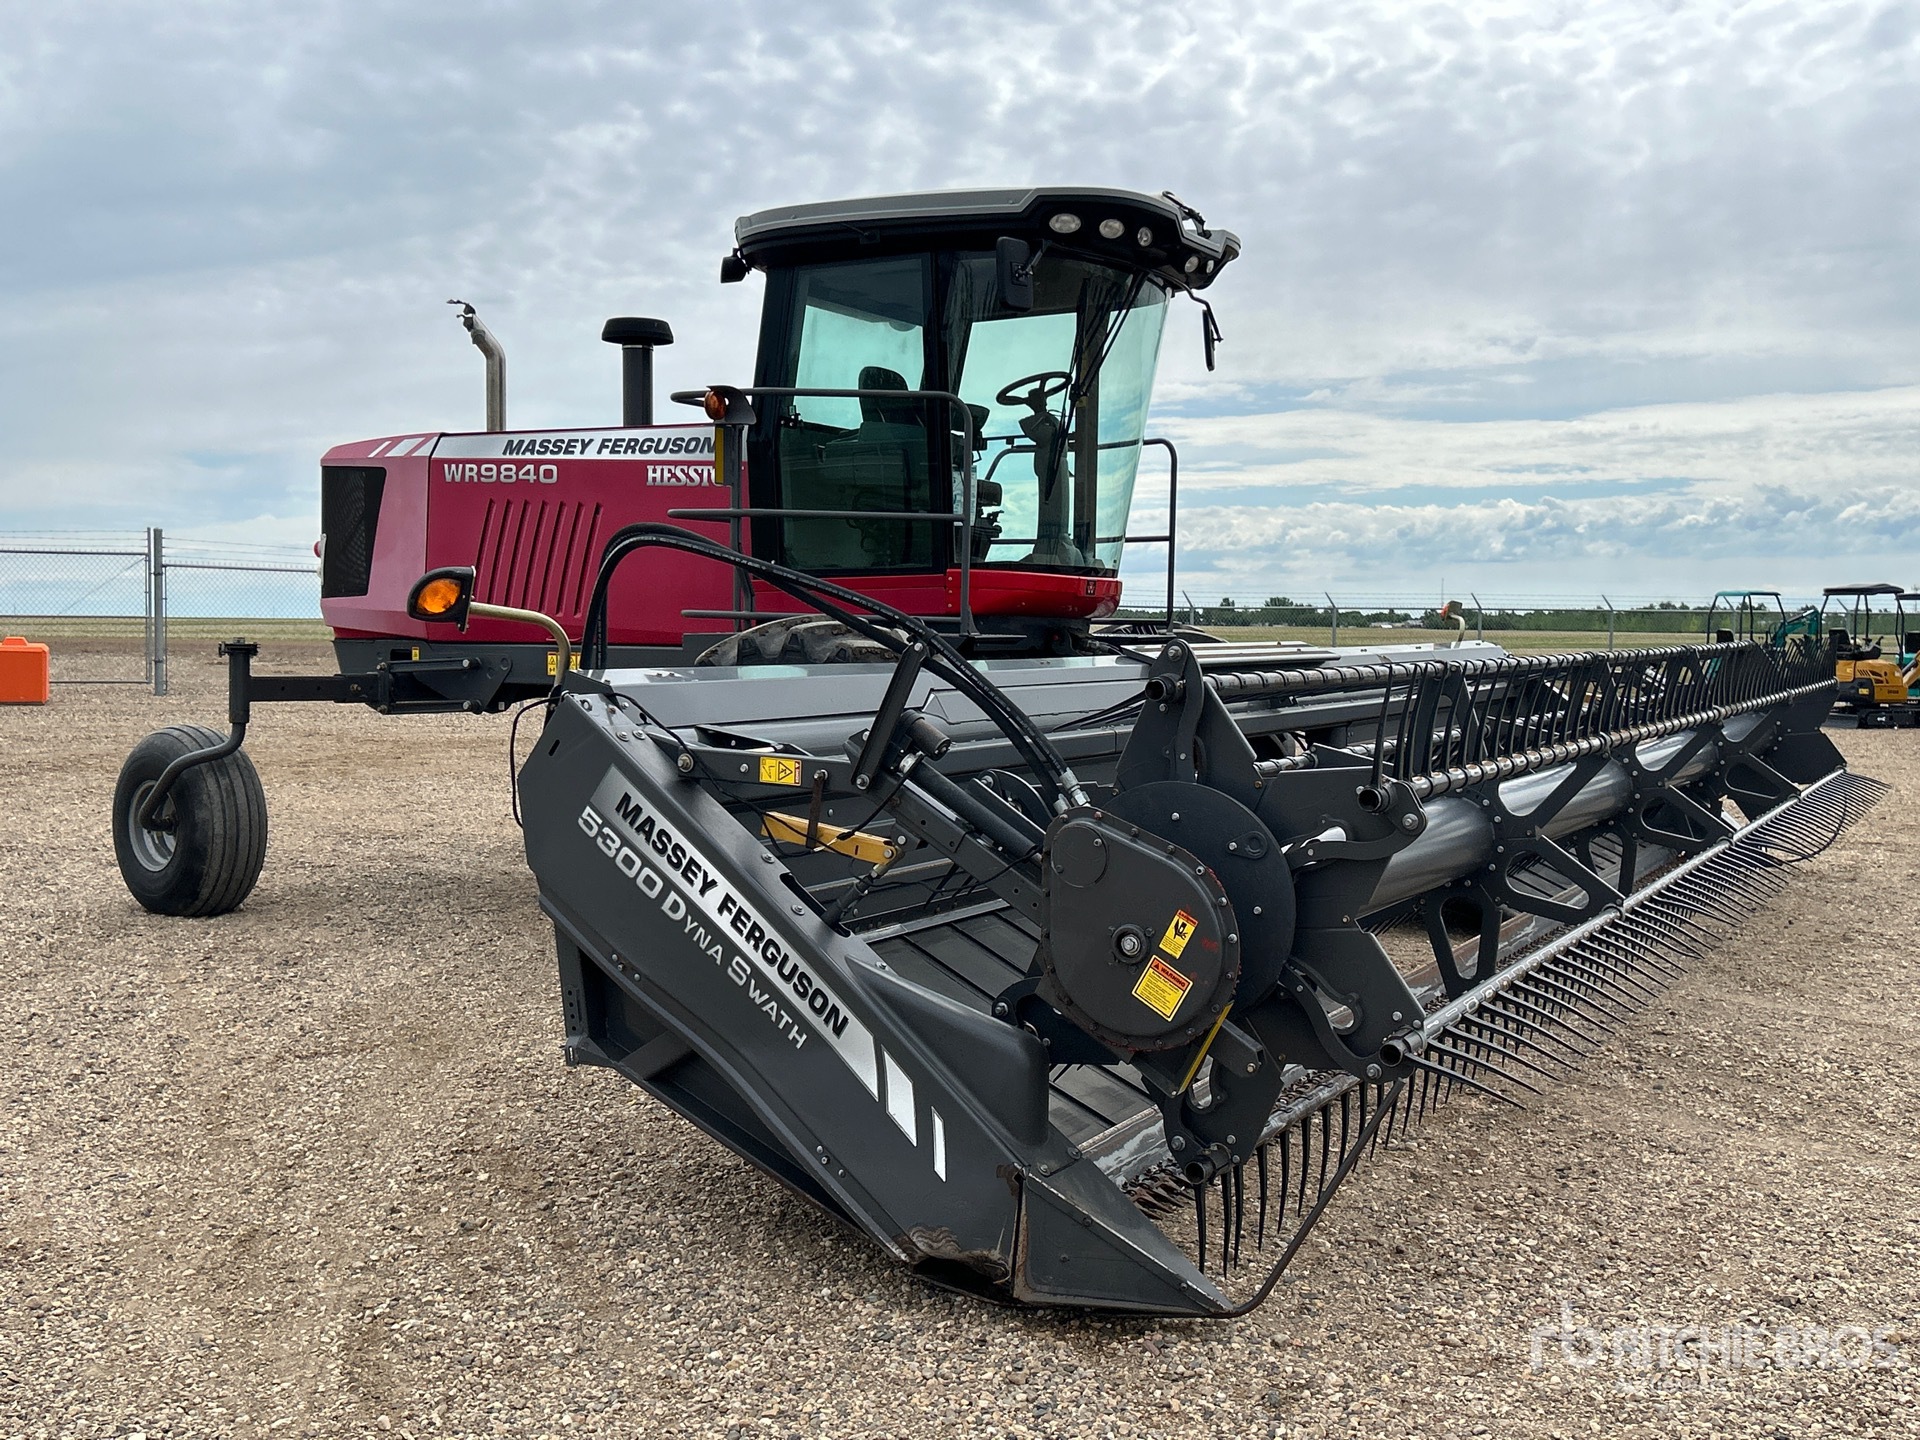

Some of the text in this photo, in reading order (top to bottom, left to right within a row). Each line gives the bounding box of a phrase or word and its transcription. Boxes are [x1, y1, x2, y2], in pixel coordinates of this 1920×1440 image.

[502, 438, 594, 456] MASSEY
[443, 463, 558, 484] WR9840
[577, 806, 663, 899] 5300
[615, 791, 849, 1040] MASSEY FERGUSON
[1160, 967, 1186, 988] WARNING
